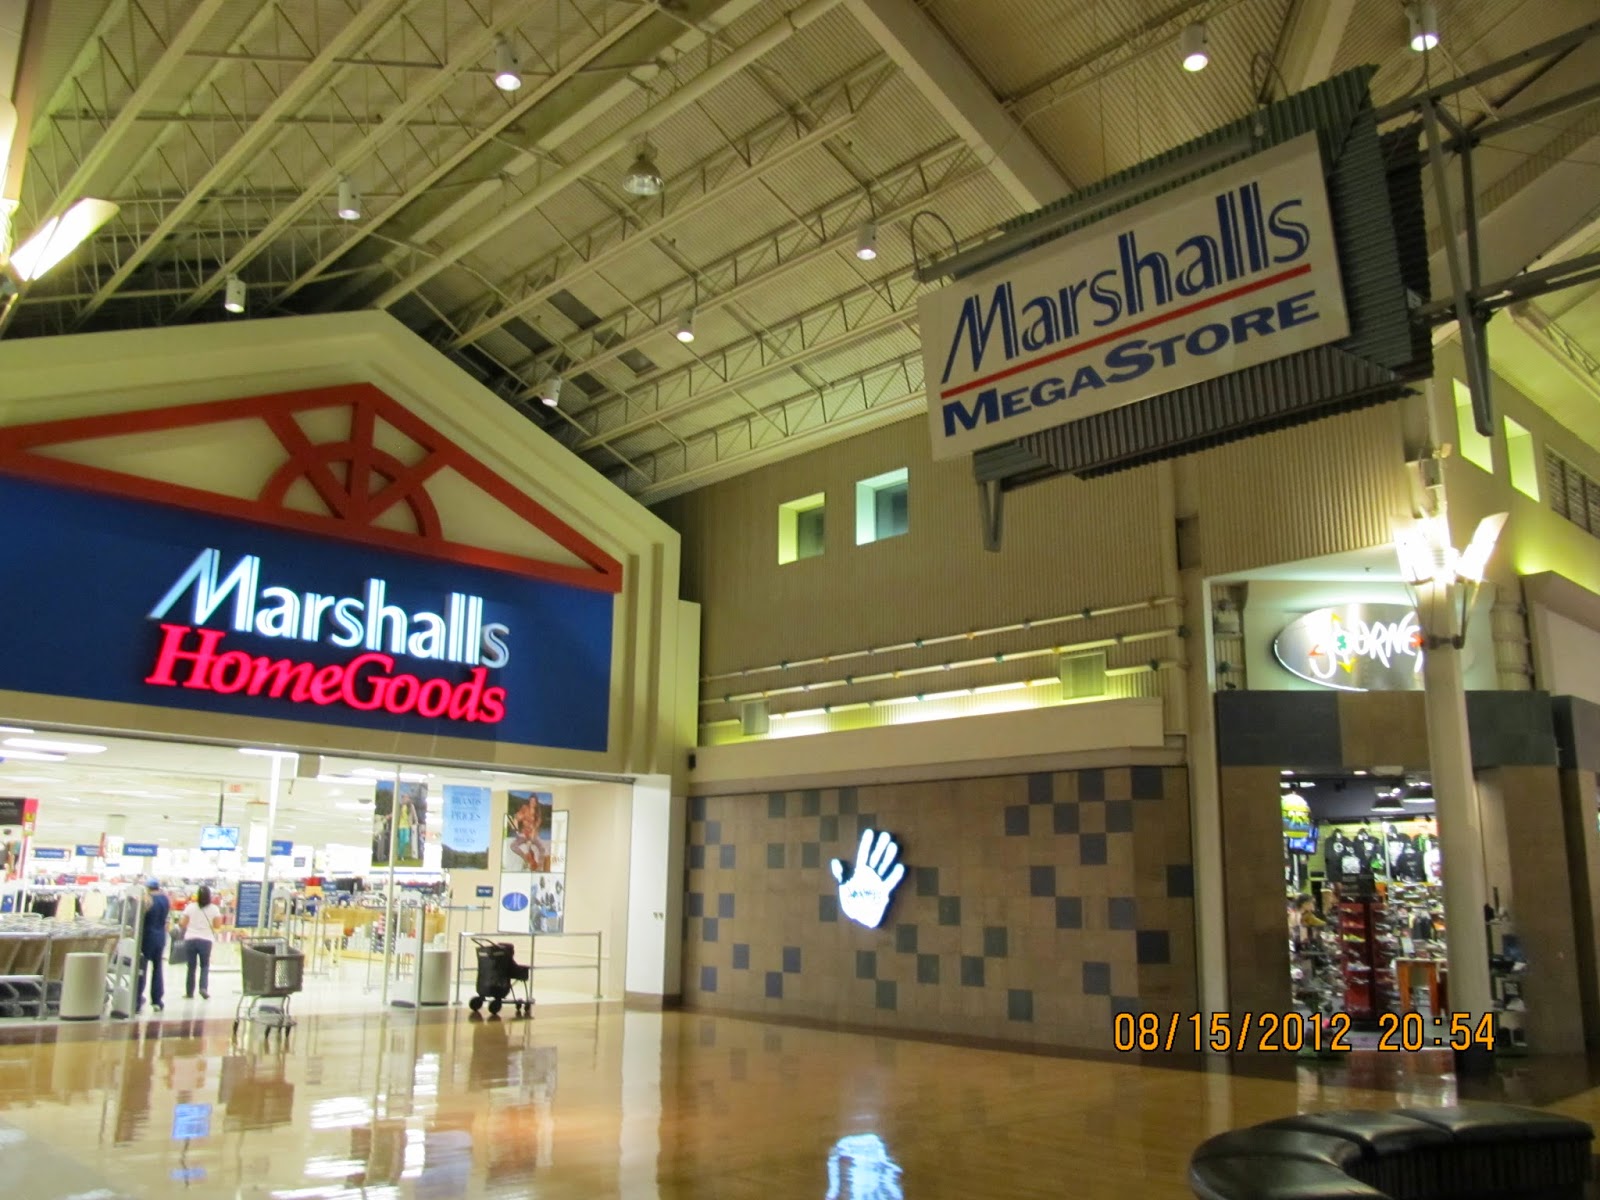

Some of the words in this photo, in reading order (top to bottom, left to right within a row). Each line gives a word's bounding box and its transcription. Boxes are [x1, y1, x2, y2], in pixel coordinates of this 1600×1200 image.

[940, 181, 1311, 385] Marshalls
[145, 547, 511, 669] Marshalls
[145, 623, 507, 724] HomeGoods
